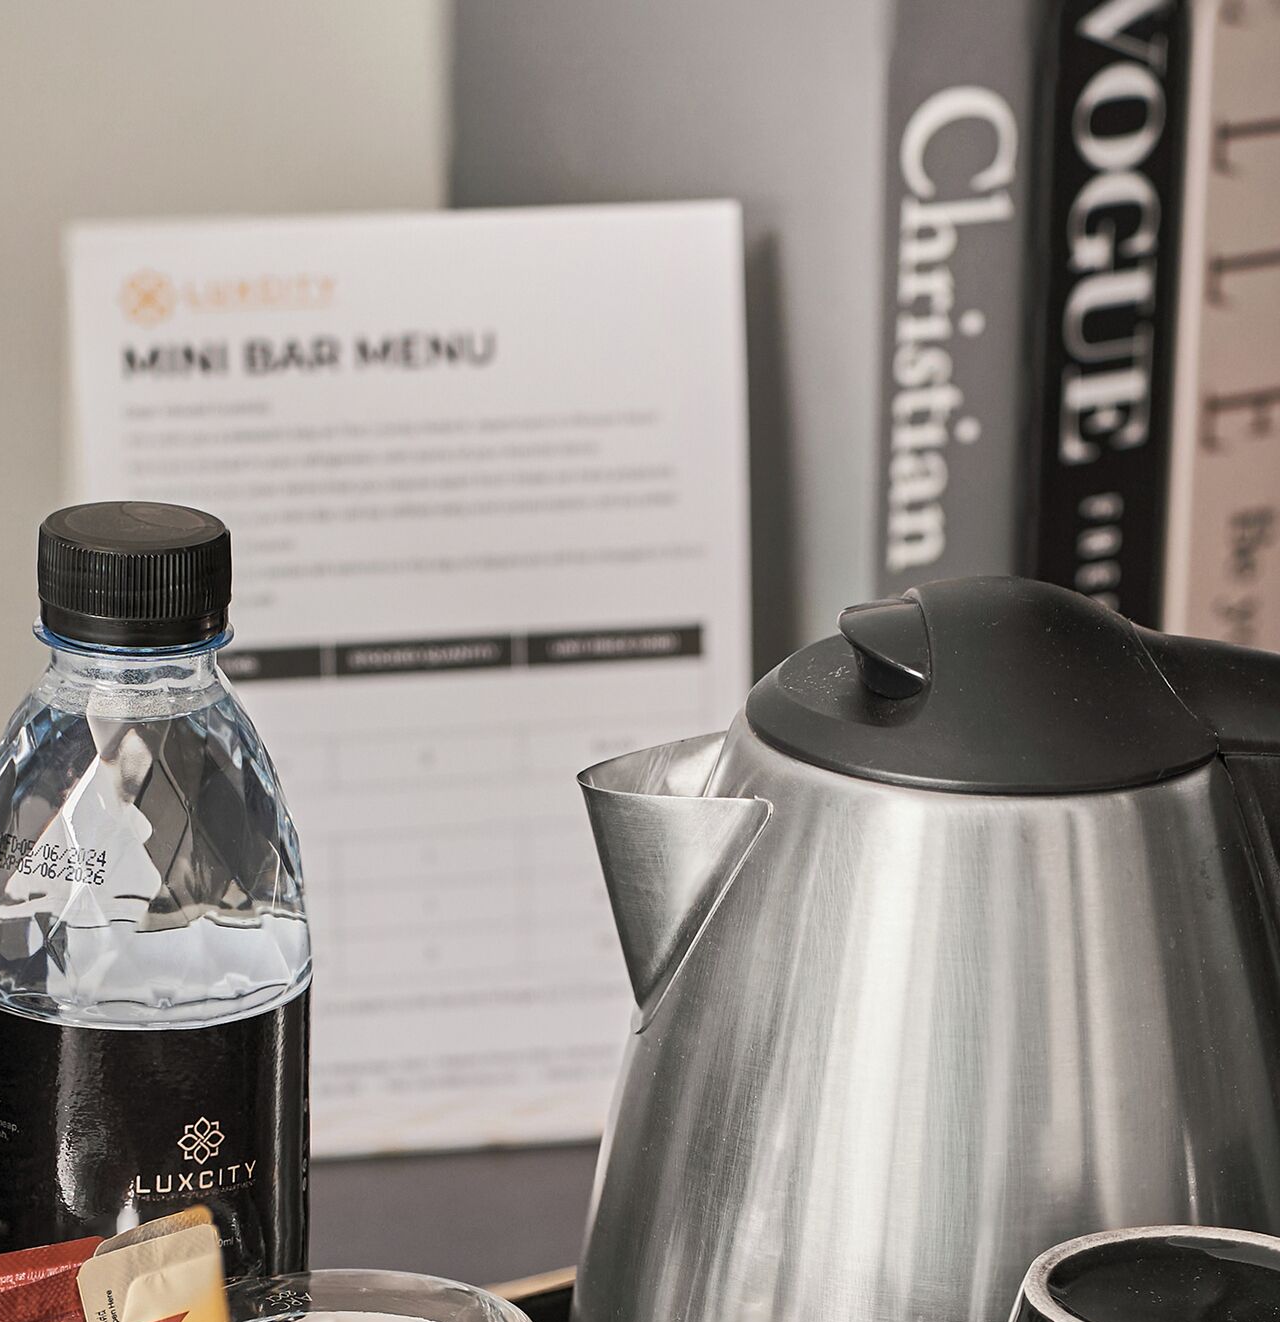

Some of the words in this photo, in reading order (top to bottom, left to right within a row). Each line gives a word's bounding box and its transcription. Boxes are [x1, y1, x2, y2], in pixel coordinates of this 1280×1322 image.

[1059, 0, 1167, 465] VOGUE
[886, 85, 1018, 572] Christian
[123, 338, 229, 379] MINI
[243, 336, 341, 374] BAR
[354, 331, 498, 371] MENU
[135, 1160, 257, 1194] LUXCITY
[105, 1289, 115, 1310] Here
